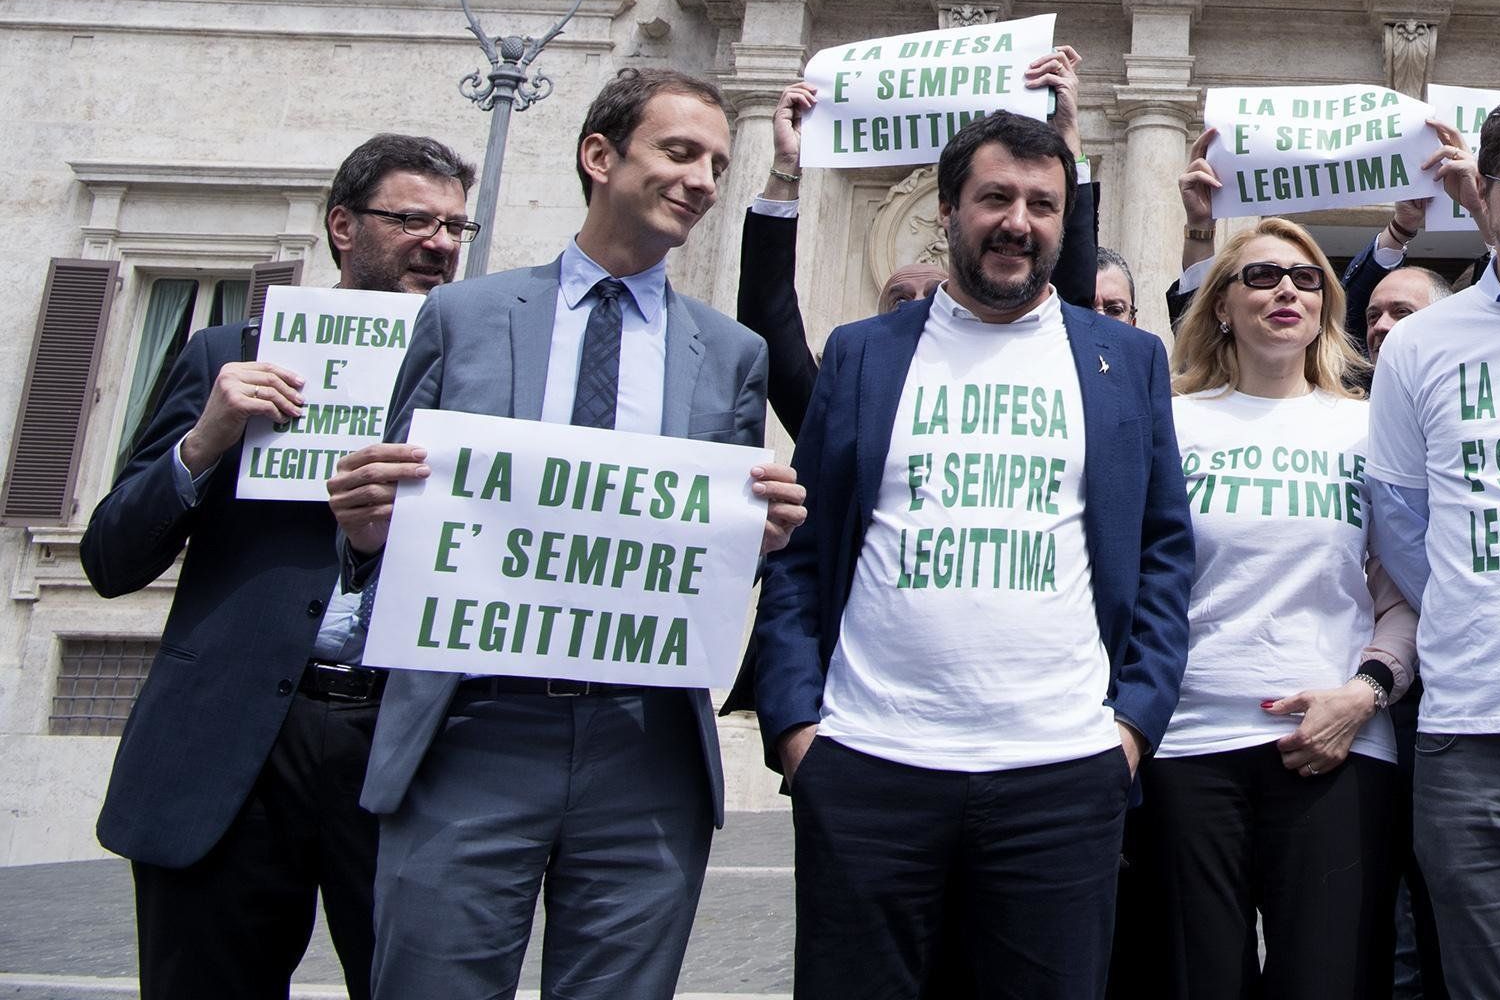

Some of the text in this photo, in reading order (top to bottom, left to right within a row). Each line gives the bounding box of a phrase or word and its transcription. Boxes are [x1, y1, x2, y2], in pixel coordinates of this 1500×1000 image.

[842, 33, 1013, 62] LA DIFESA
[834, 65, 1014, 103] E' SEMPRE
[1238, 92, 1400, 120] LA DIFESA
[833, 110, 985, 153] LEGITTI
[1235, 113, 1402, 155] E' SEMPRE
[1236, 154, 1410, 203] LEGITTIMA
[273, 311, 406, 349] LA DIFESA
[323, 359, 348, 390] E'
[1459, 361, 1496, 421] LA
[912, 383, 1068, 440] LA DIFESA
[249, 446, 358, 480] LEGITT
[451, 447, 710, 524] LA DIFESA
[908, 452, 1067, 515] E' SEMPRE
[1209, 445, 1262, 470] STO
[1272, 446, 1328, 476] CON
[1338, 452, 1367, 485] LE
[1461, 439, 1486, 492] E'
[433, 521, 708, 595] E' SEMPRE
[896, 526, 1058, 592] LEGITTIMA
[416, 597, 688, 666] LEGITTIMA
